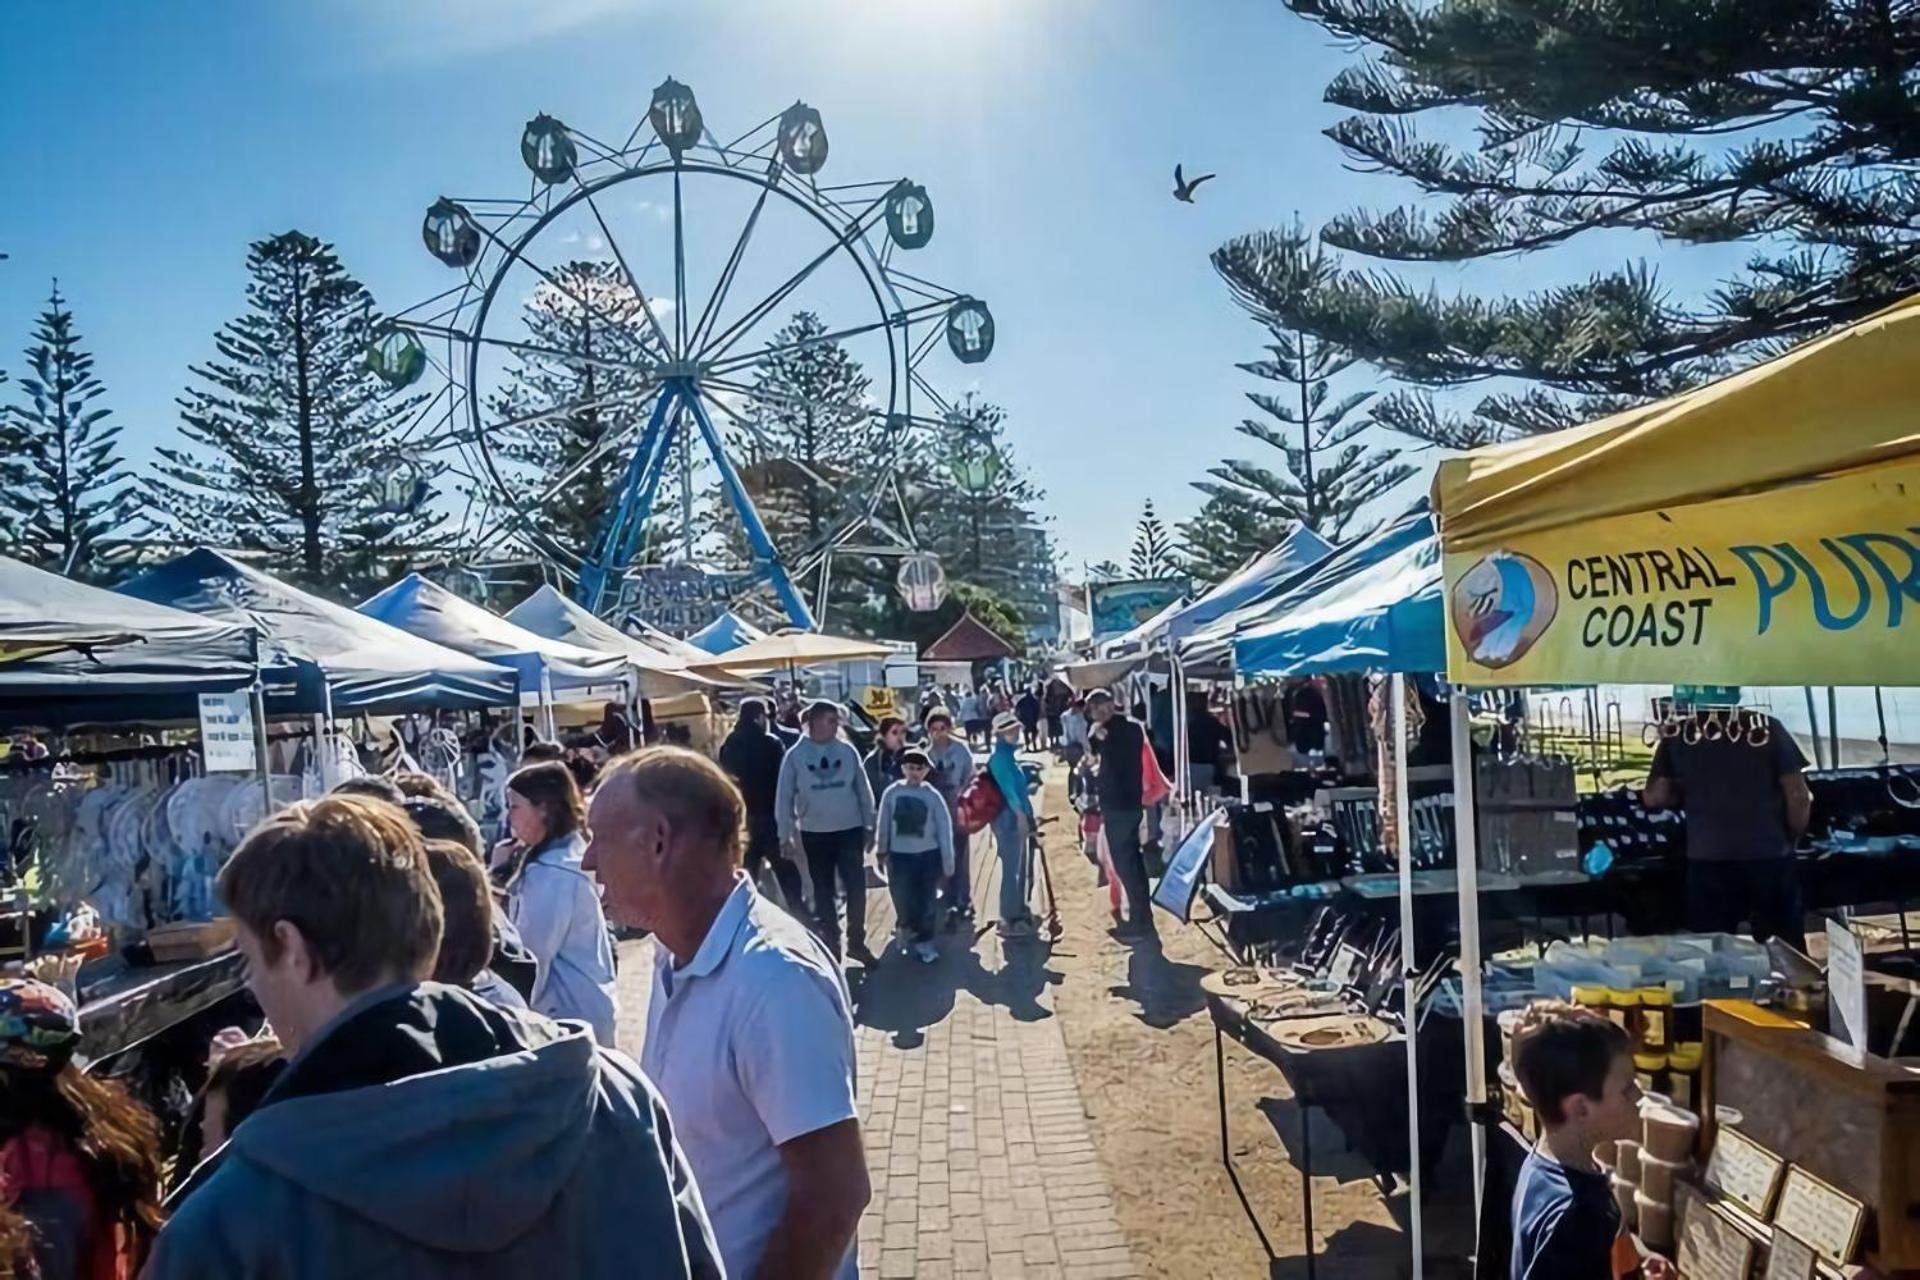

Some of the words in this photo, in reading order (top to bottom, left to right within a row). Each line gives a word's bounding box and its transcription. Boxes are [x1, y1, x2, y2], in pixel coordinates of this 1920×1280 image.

[1568, 547, 1736, 599] CENTRAL
[1729, 527, 1920, 635] PUR
[1582, 599, 1713, 647] COAST
